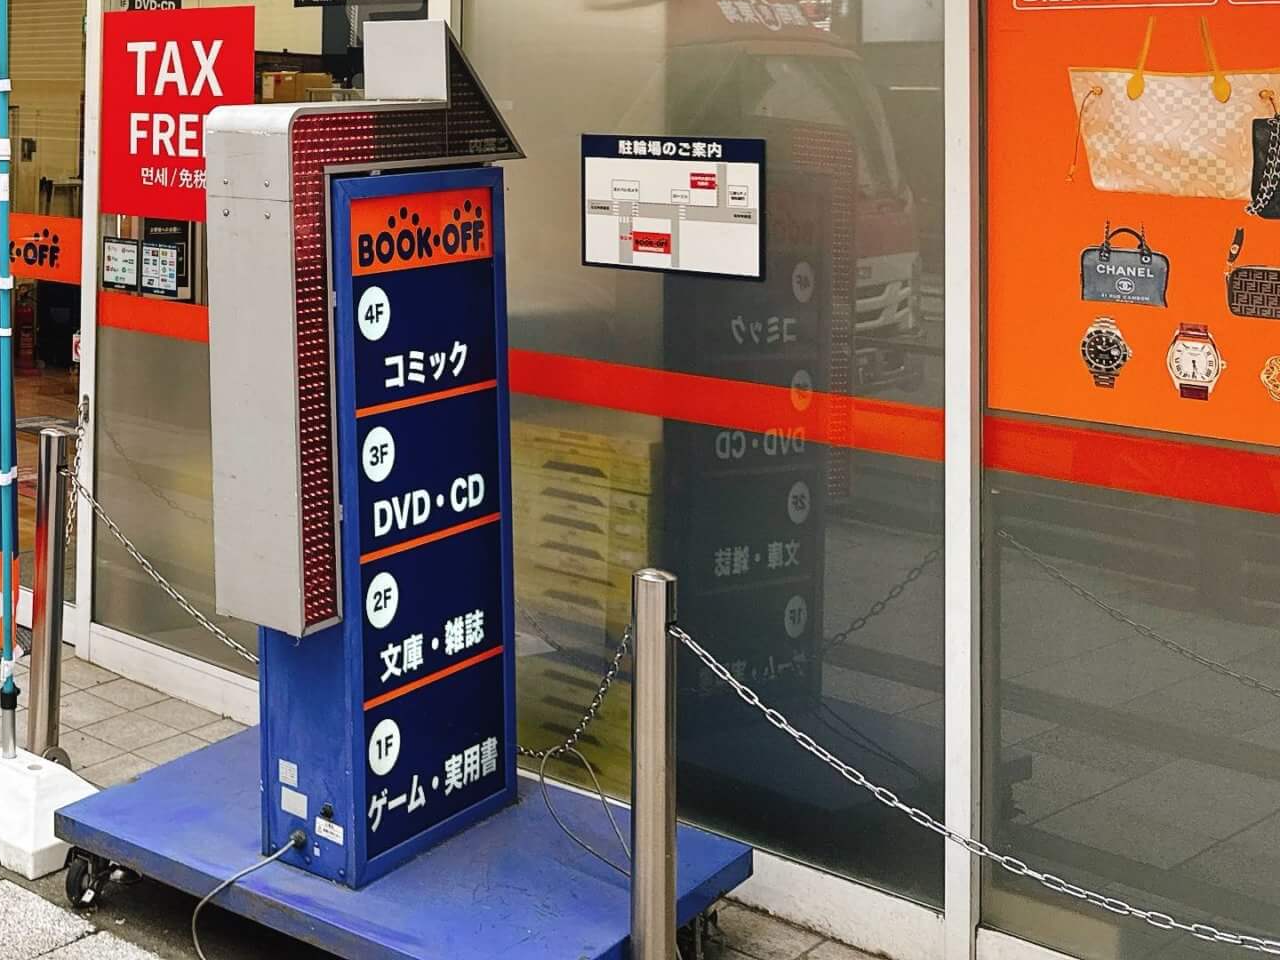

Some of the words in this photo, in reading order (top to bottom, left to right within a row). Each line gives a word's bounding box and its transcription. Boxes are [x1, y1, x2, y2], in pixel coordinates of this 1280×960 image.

[127, 40, 224, 97] TAX
[618, 140, 722, 158] 駐輪場のご案内
[1096, 264, 1154, 278] CHANEL
[364, 302, 384, 325] 4F
[384, 340, 469, 389] コミック
[368, 443, 389, 467] 3F
[373, 473, 485, 538] DVD・CD
[373, 588, 393, 613] 2F
[379, 609, 486, 683] 文庫・雑誌
[375, 734, 394, 760] 1F
[367, 736, 499, 834] ゲーム・実用書
